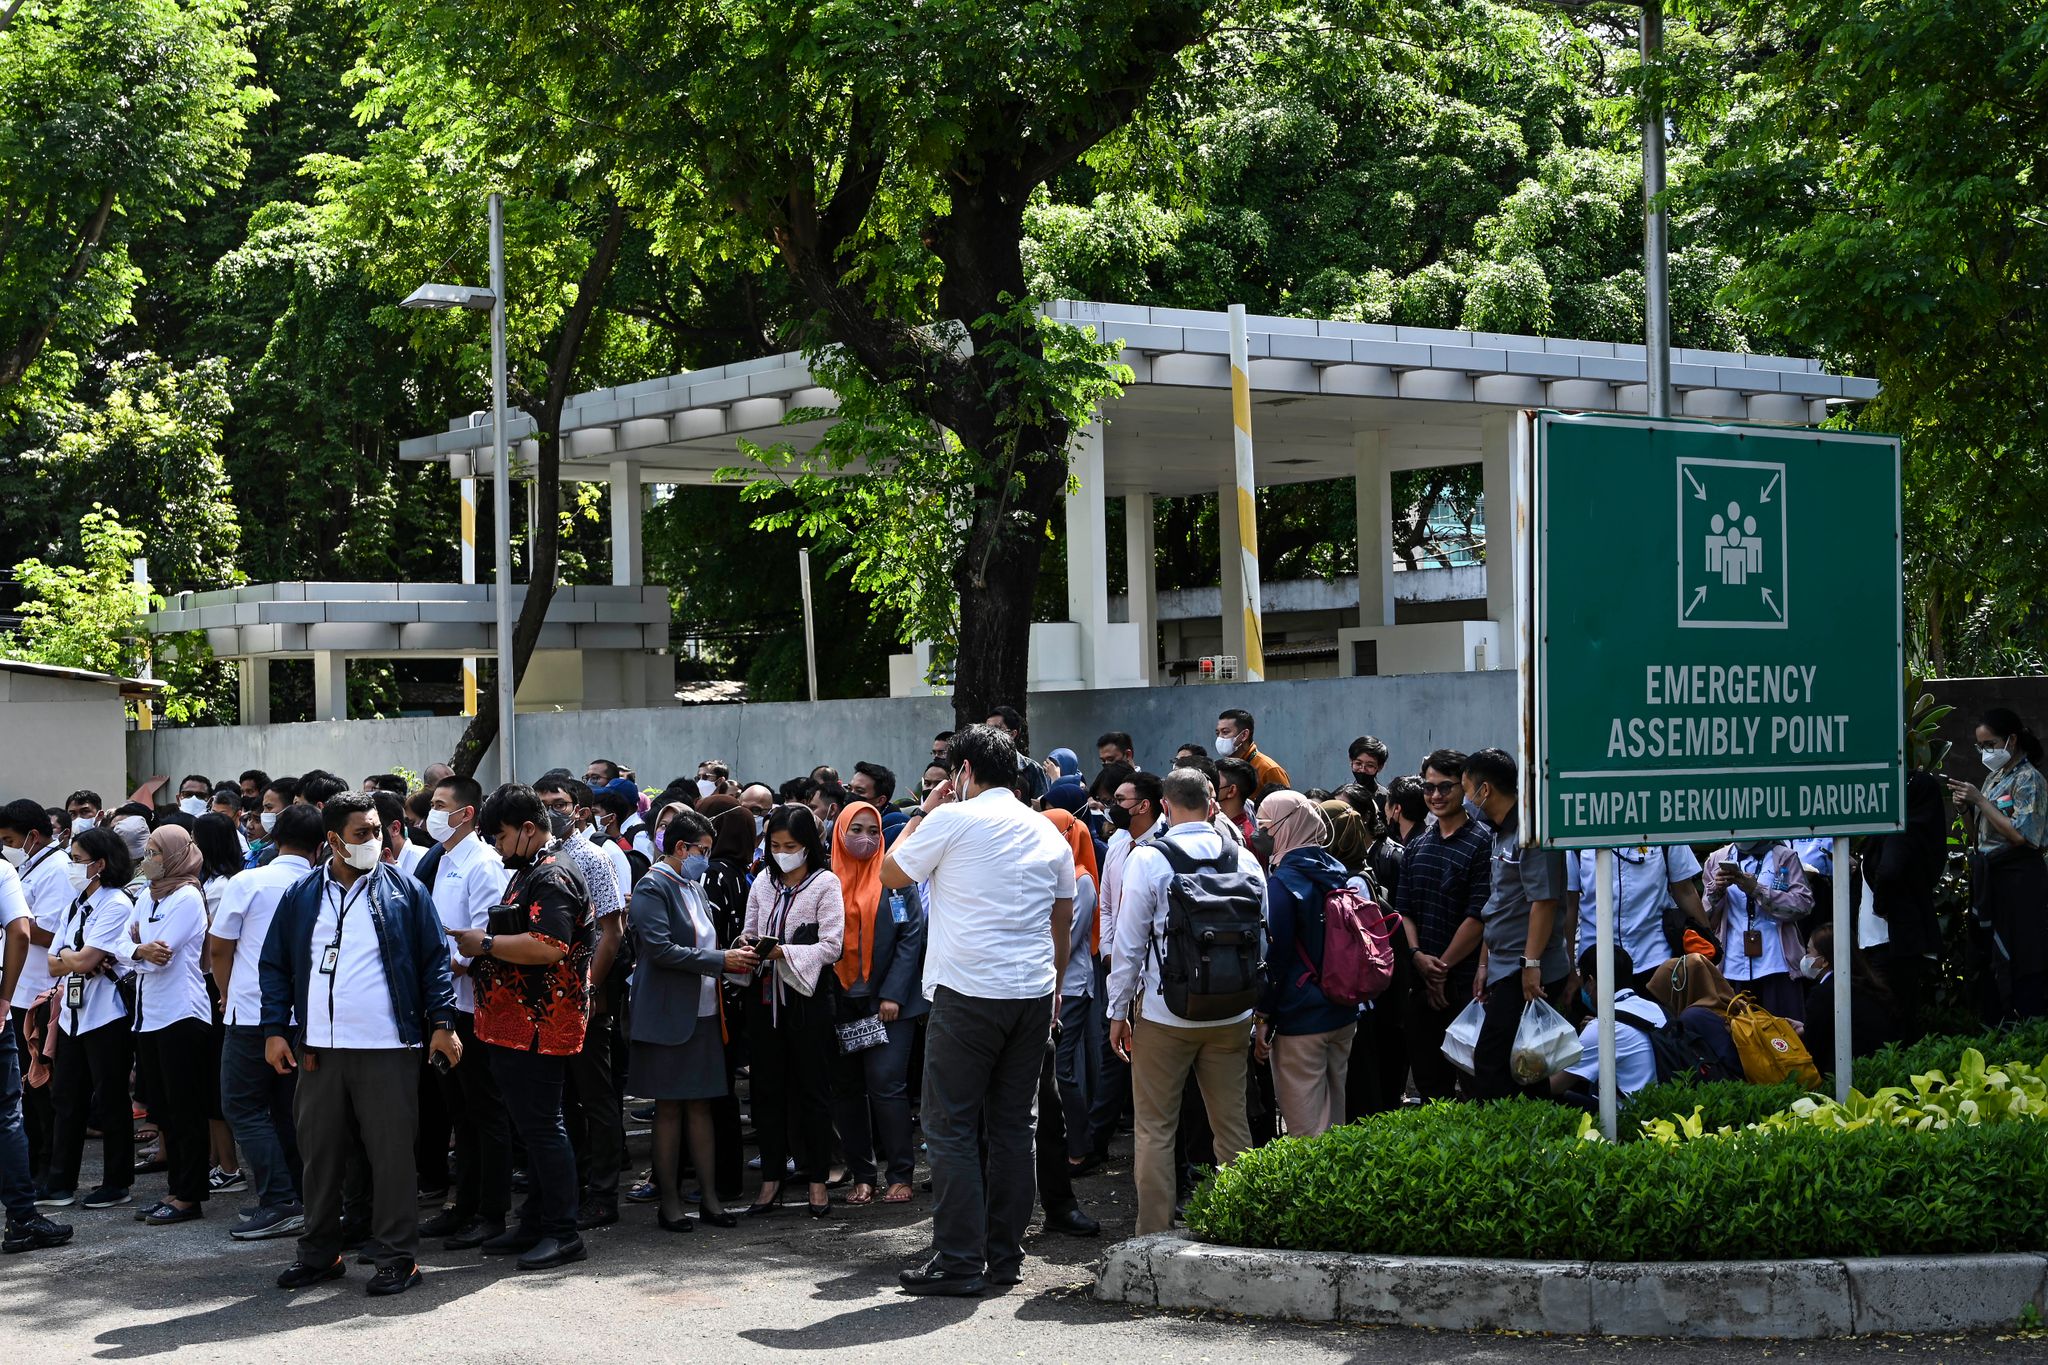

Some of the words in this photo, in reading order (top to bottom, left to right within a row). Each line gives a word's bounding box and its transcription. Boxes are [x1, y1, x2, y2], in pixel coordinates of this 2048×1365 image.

[1646, 665, 1817, 704] EMERGENCY
[1607, 716, 1761, 758] ASSEMBLY
[1771, 715, 1849, 754] POINT
[1559, 790, 1651, 826] TEMPAT
[1660, 786, 1791, 823] BERKUMPUL
[1799, 782, 1890, 816] DARURAT
